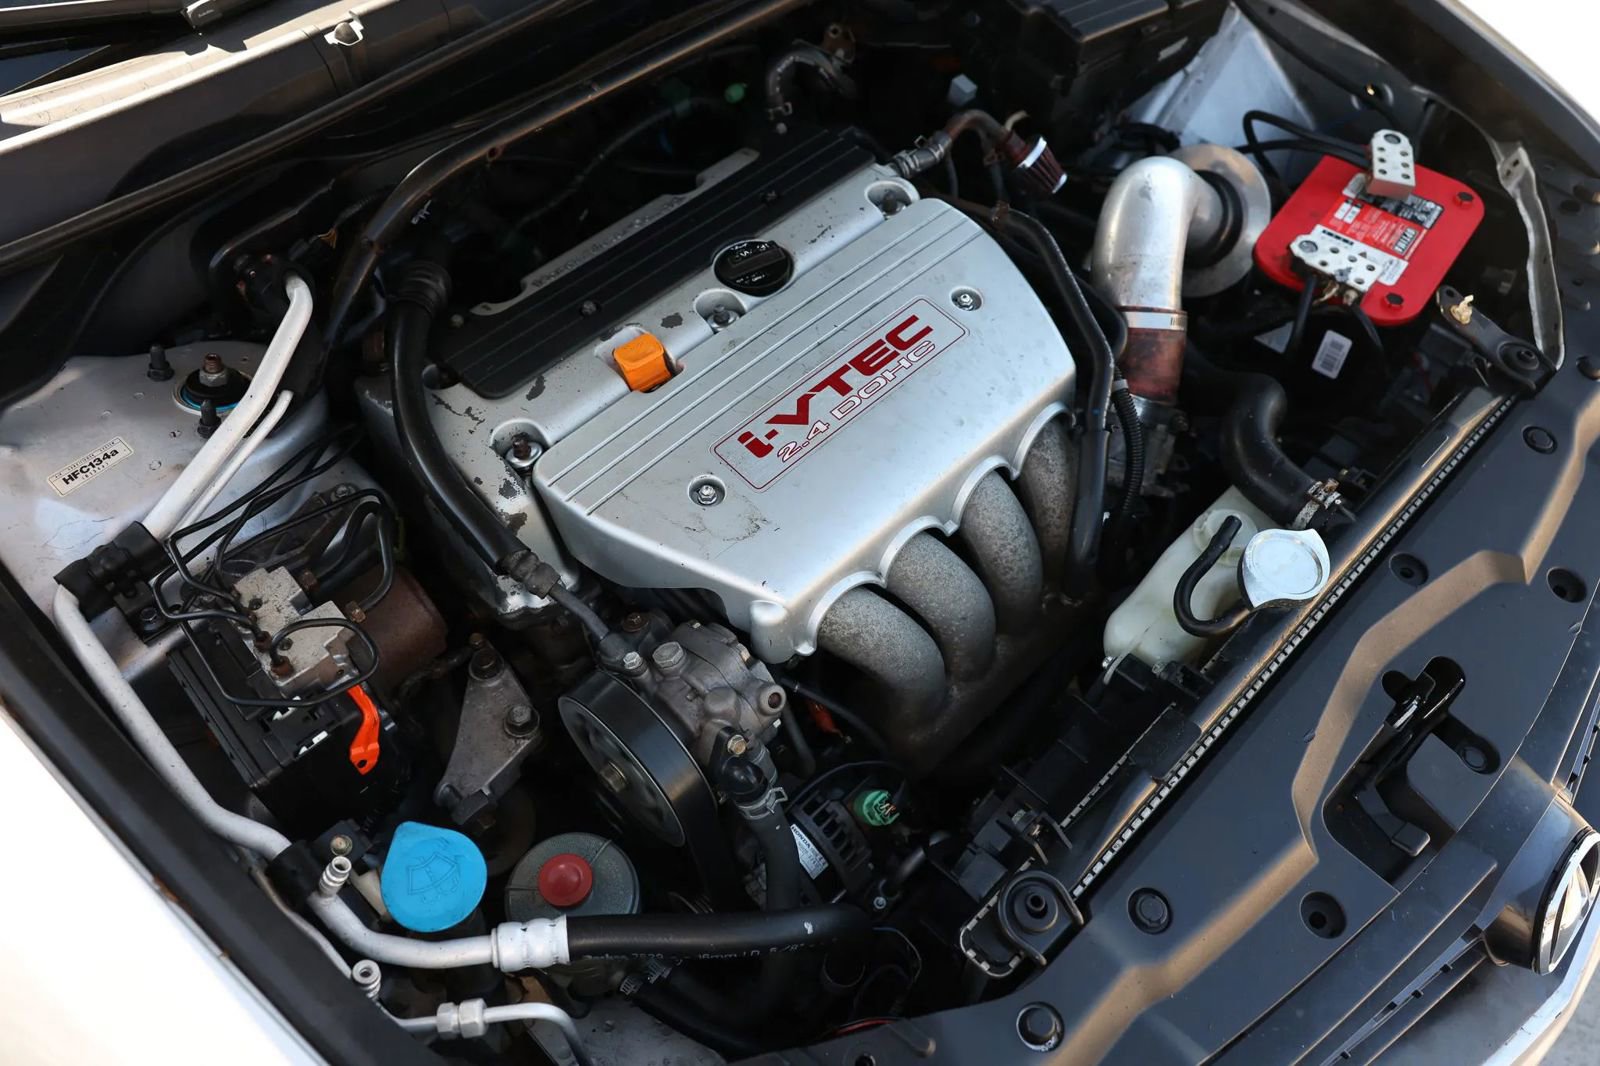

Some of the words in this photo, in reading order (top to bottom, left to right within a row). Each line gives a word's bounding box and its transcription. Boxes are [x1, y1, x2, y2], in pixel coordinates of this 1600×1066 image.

[776, 420, 831, 463] 2.4
[830, 339, 936, 421] DOHC
[62, 449, 119, 485] HFC134a
[791, 825, 811, 849] HONDA
